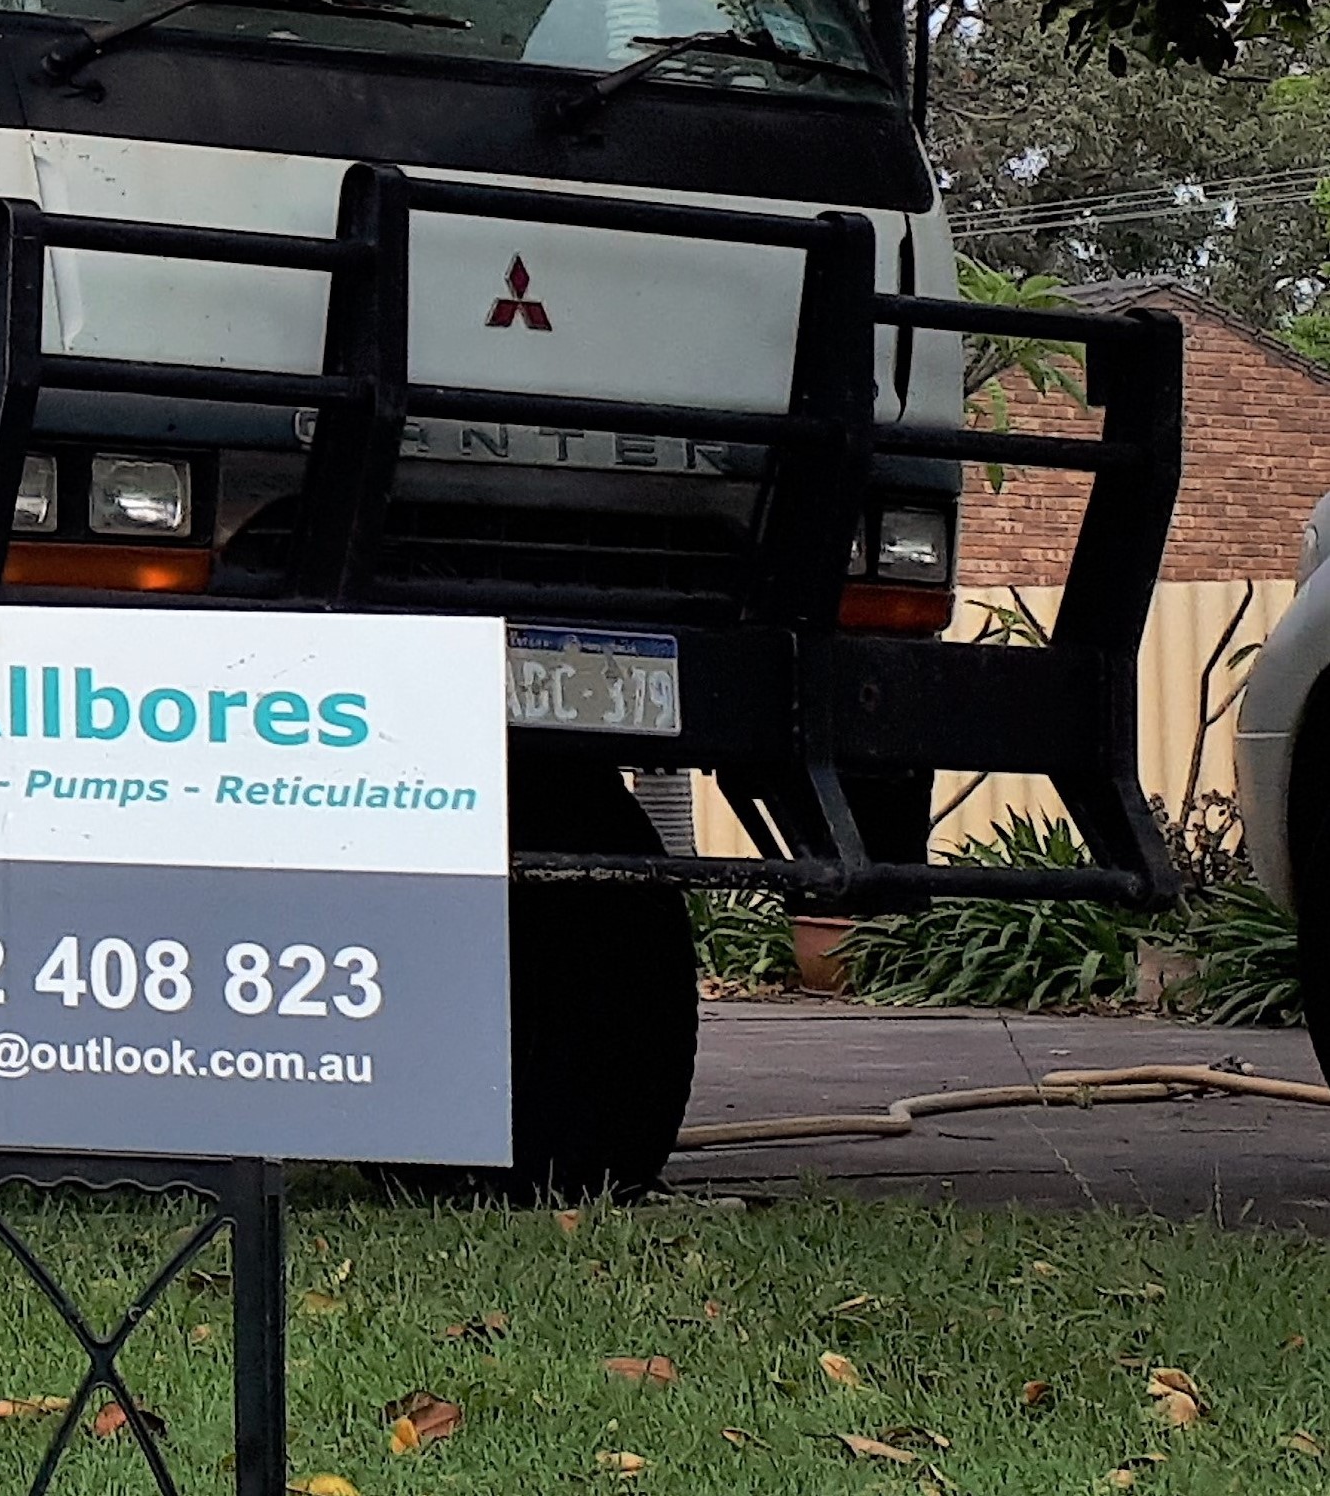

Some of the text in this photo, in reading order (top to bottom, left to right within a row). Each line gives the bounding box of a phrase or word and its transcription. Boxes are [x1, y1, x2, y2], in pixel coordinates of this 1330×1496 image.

[24, 769, 170, 808] Pumps
[214, 774, 478, 812] Reticulation
[34, 935, 193, 1012] 408
[223, 942, 382, 1019] 823
